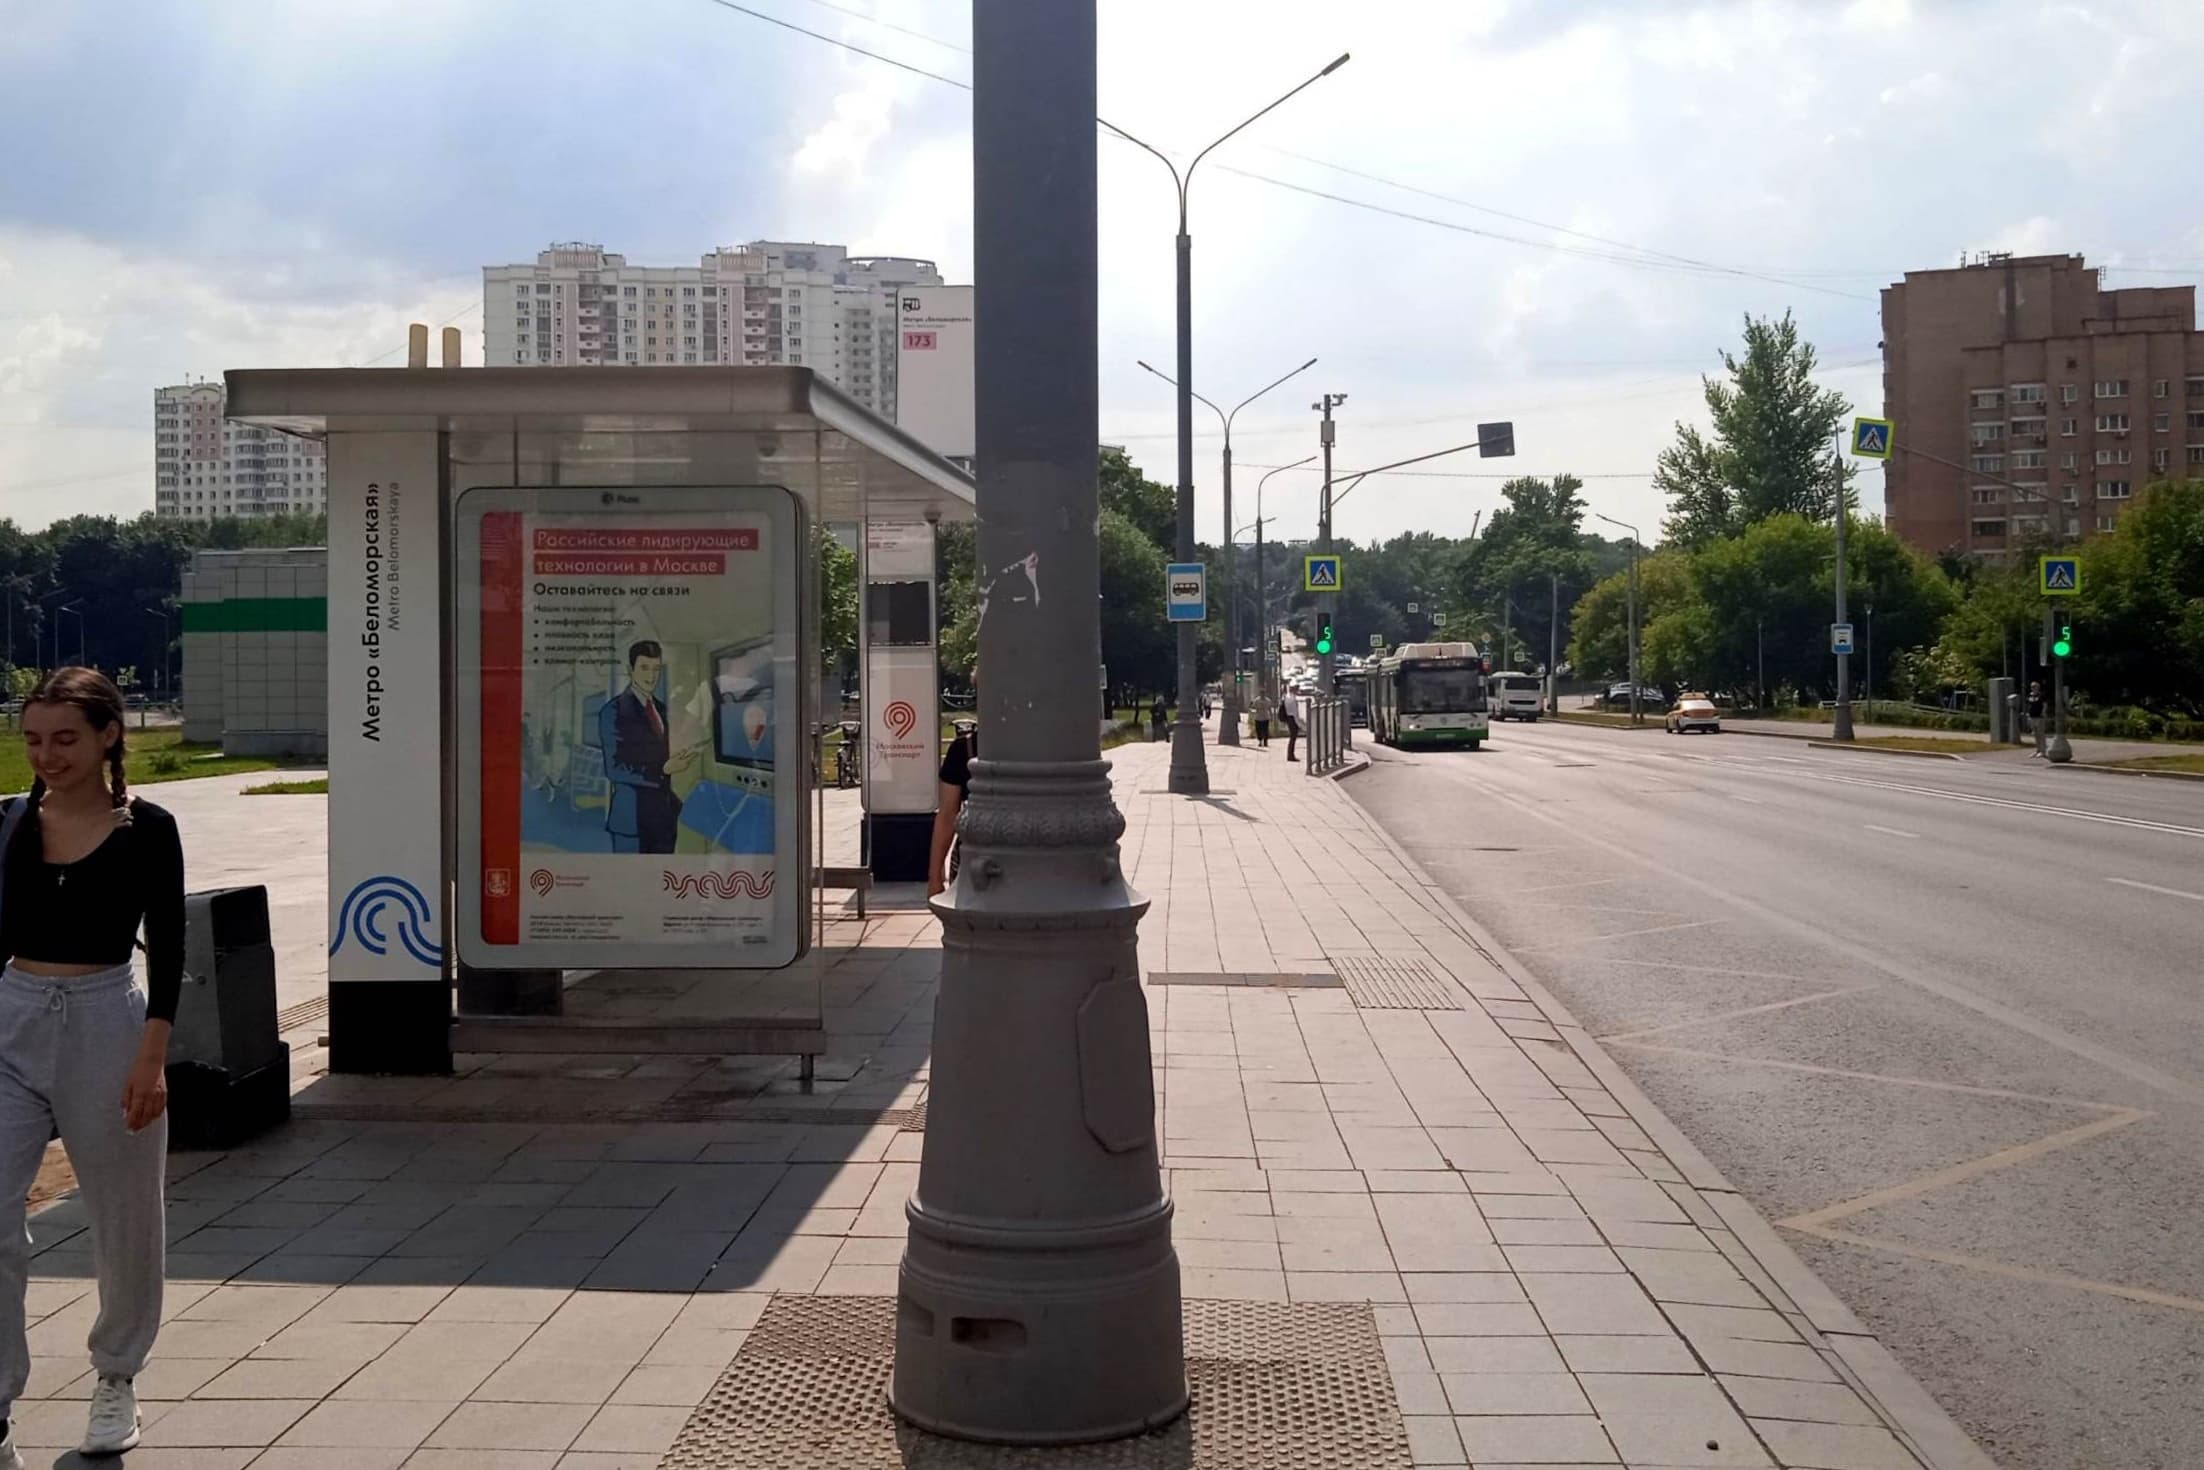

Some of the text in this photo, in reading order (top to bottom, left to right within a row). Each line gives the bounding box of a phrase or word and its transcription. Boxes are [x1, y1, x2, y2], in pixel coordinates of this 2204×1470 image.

[908, 335, 931, 347] 173
[537, 531, 750, 551] Российские лидирующие
[387, 482, 402, 630] Metro Belomorskaya
[537, 558, 718, 573] технологии в Москве
[533, 583, 690, 597] Оставайтесь на связи
[362, 483, 384, 742] Метро «Беломорская»
[1324, 626, 1331, 640] 5
[2062, 626, 2071, 640] 5
